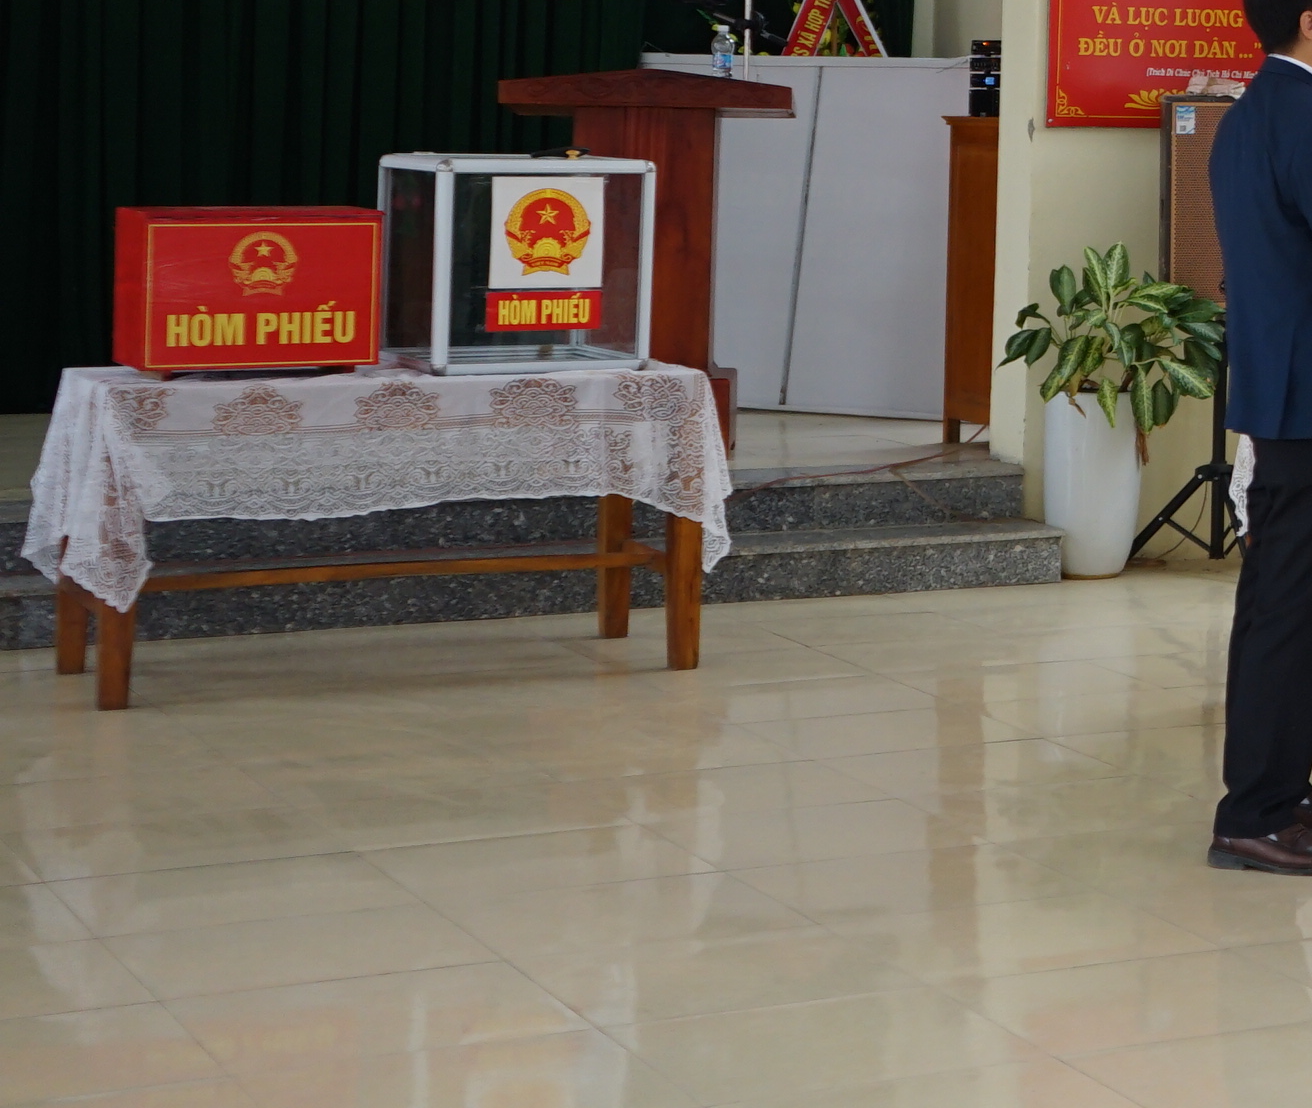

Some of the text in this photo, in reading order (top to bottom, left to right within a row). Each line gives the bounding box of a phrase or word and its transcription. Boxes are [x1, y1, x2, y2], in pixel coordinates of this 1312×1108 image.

[1078, 31, 1236, 59] ĐỀU Ở NƠI DÂN
[166, 301, 356, 349] HÒM PHIẾU
[497, 293, 590, 327] HÒM PHIẾU
